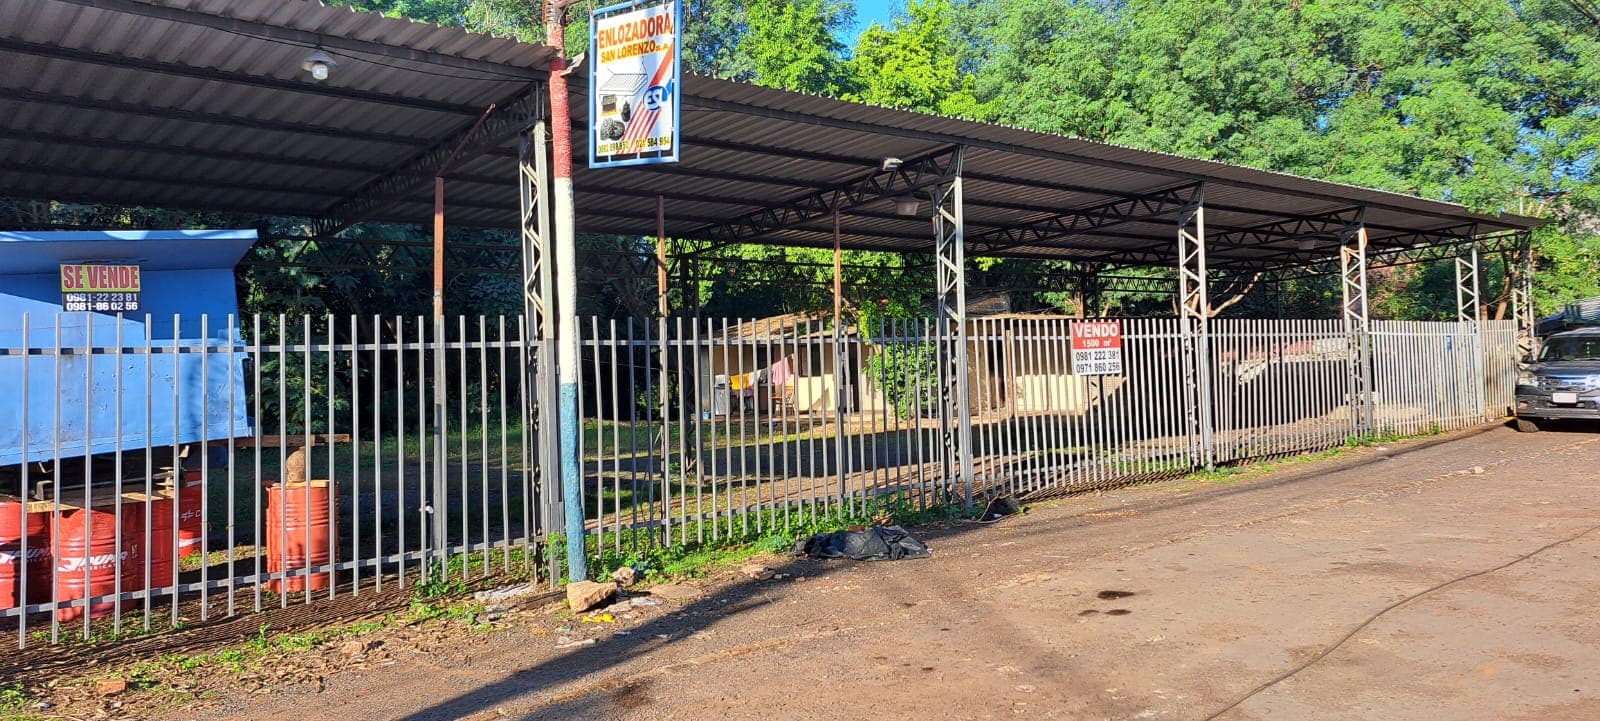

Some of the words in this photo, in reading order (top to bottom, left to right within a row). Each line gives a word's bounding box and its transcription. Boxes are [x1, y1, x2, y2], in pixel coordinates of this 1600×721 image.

[598, 12, 673, 49] ENLOZADORA
[601, 50, 615, 63] SAN
[617, 40, 656, 59] LORENZO
[63, 265, 84, 289] SE
[86, 265, 139, 289] VENDE
[111, 293, 124, 302] 23
[111, 302, 124, 311] 02
[125, 302, 138, 311] 56
[1074, 323, 1119, 338] VENDO
[1082, 339, 1100, 348] 1500
[1076, 351, 1092, 361] 0981
[1094, 351, 1106, 360] 222
[1107, 350, 1119, 360] 381
[1076, 363, 1092, 373] 0971
[1094, 362, 1106, 372] 860
